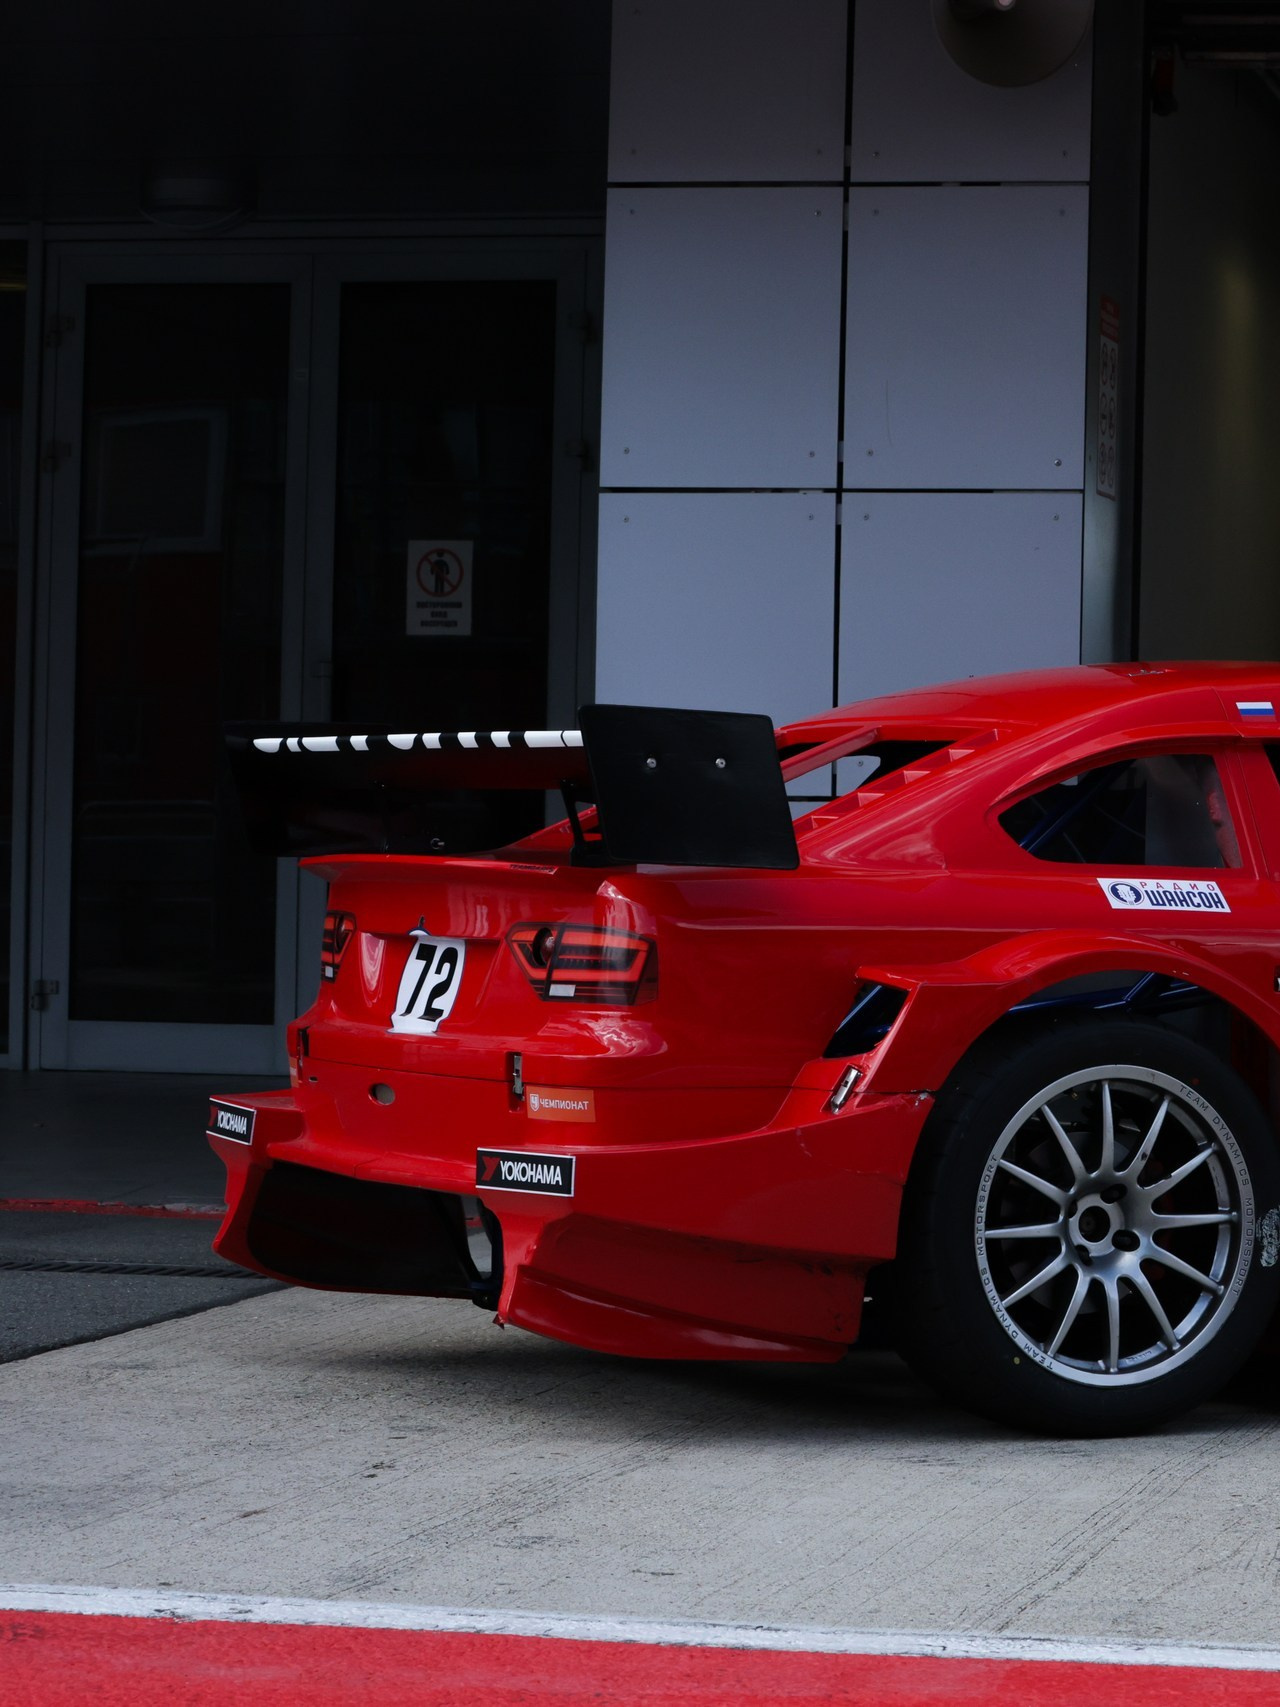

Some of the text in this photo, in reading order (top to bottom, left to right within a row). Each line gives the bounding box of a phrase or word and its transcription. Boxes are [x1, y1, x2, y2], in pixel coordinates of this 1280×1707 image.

[1139, 881, 1216, 892] РАДИО
[1145, 890, 1225, 909] ШАНСОН
[402, 943, 459, 1022] 72
[540, 1098, 589, 1111] ЧЕМПИОНАТ
[216, 1110, 248, 1135] YOKOHAMA
[500, 1159, 562, 1187] YOKOHAMA
[1178, 1084, 1254, 1298] TEAM DYNAMICS MOTORSPORT
[976, 1153, 1054, 1371] TEAM DYNAMICS MOTORSPORT
